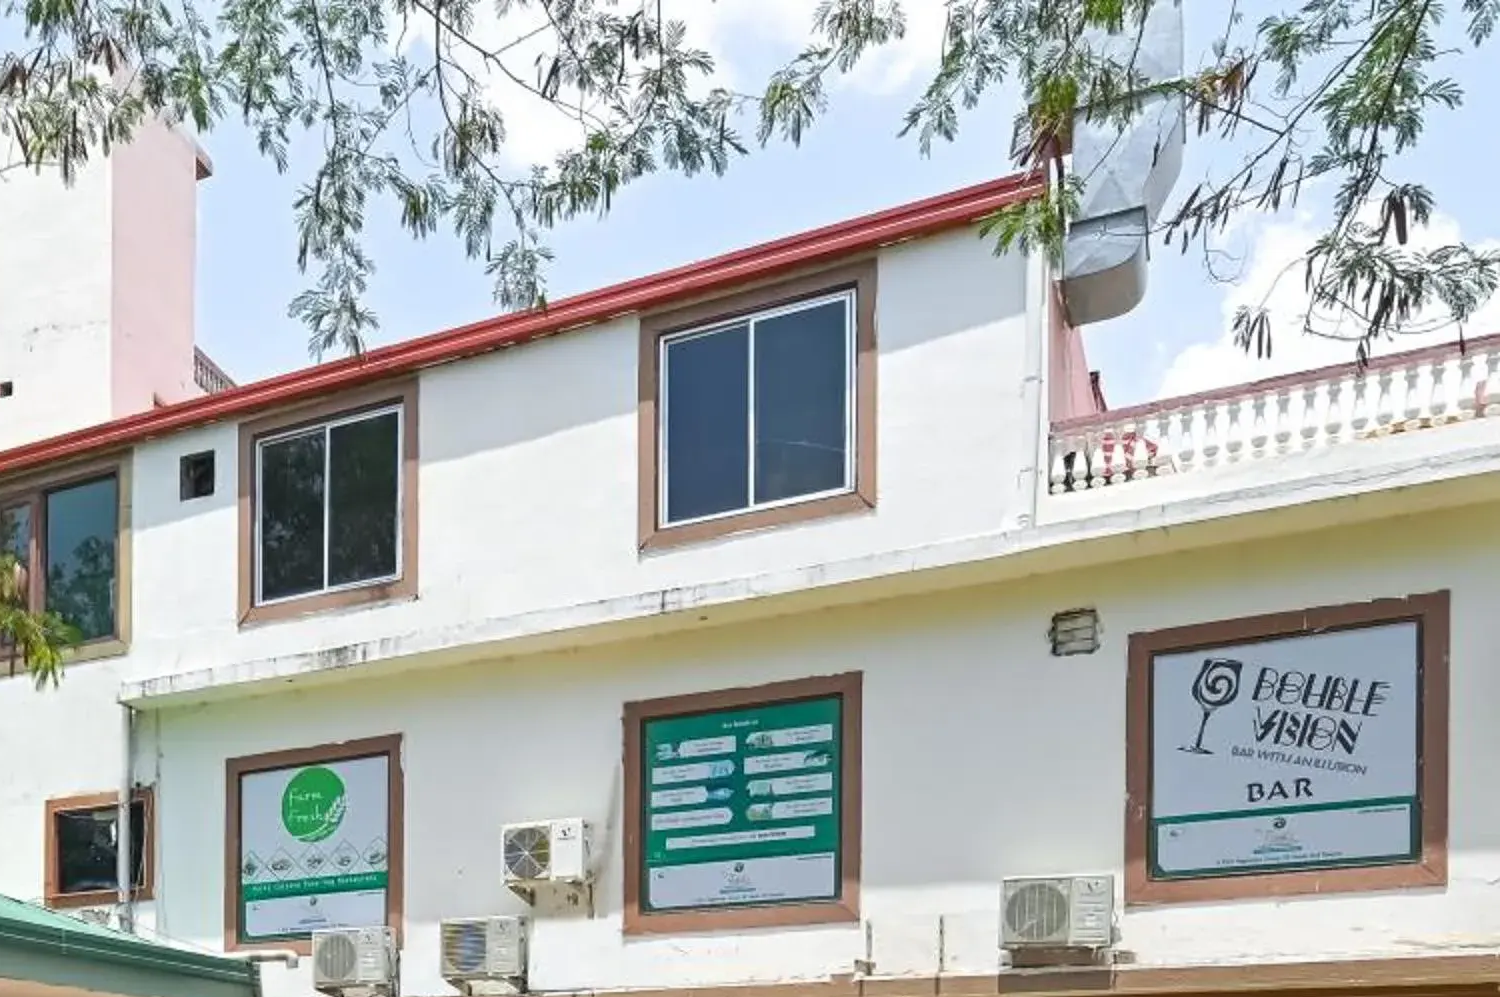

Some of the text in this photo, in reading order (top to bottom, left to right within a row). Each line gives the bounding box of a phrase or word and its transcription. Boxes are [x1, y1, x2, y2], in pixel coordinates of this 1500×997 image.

[1252, 667, 1392, 717] DOUBLE
[1253, 705, 1363, 755] VISION
[1247, 778, 1313, 802] BAR
